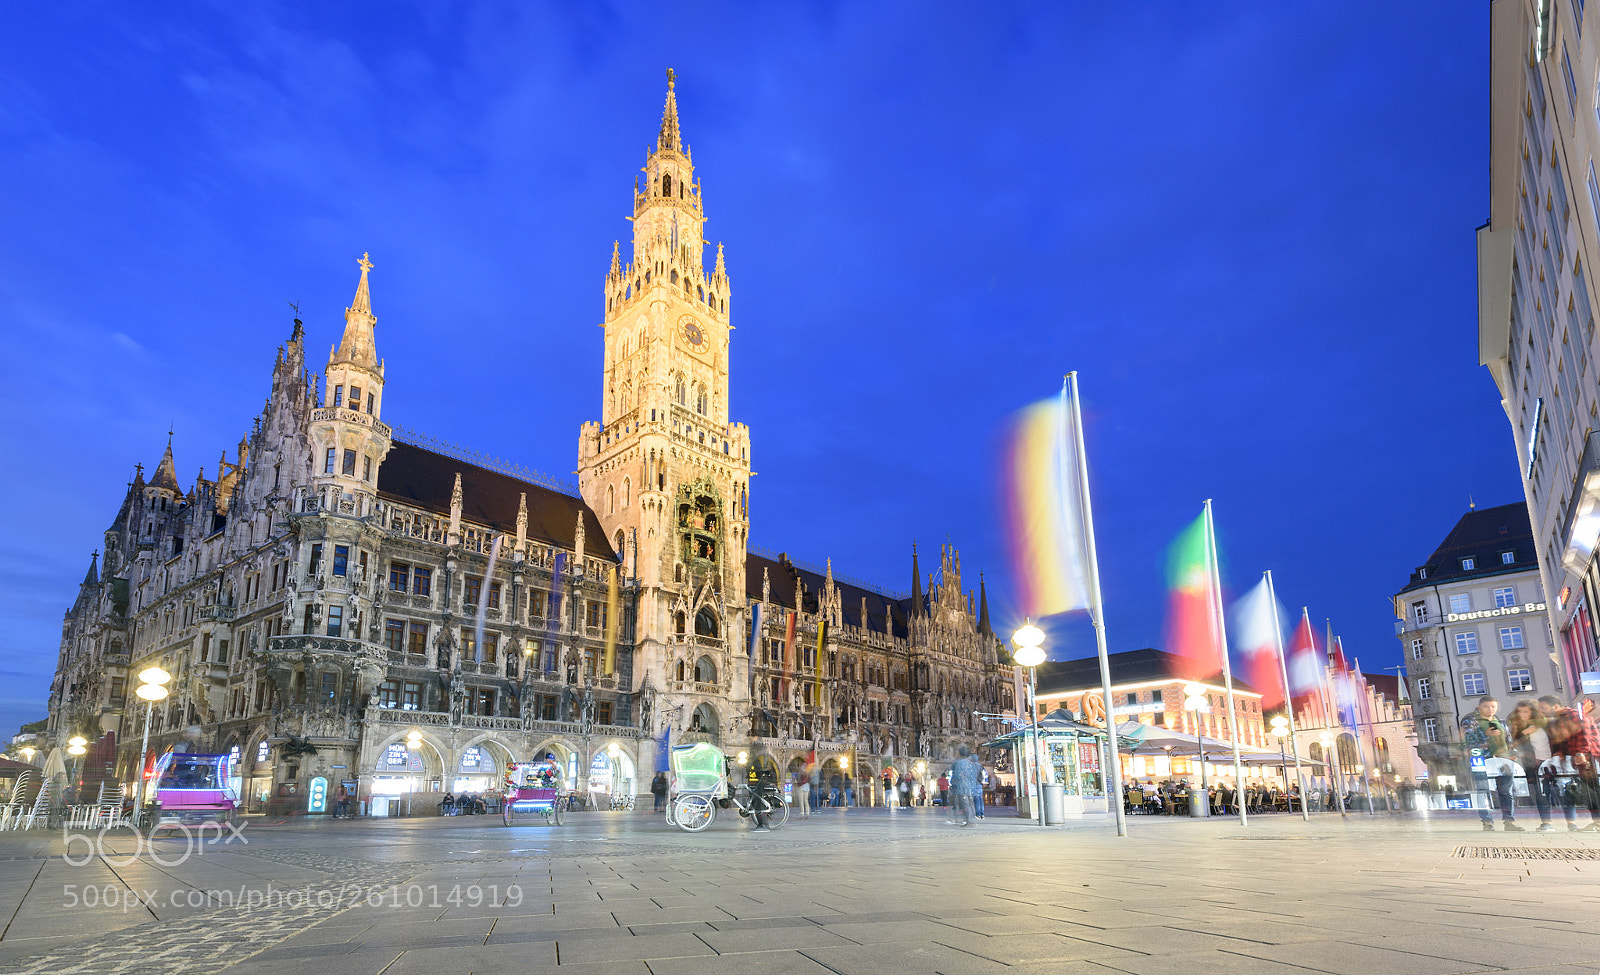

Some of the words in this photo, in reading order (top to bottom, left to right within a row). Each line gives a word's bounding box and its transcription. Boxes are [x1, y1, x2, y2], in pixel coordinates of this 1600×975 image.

[1447, 606, 1521, 622] Deutsche
[1470, 747, 1482, 757] S
[1472, 757, 1482, 766] U
